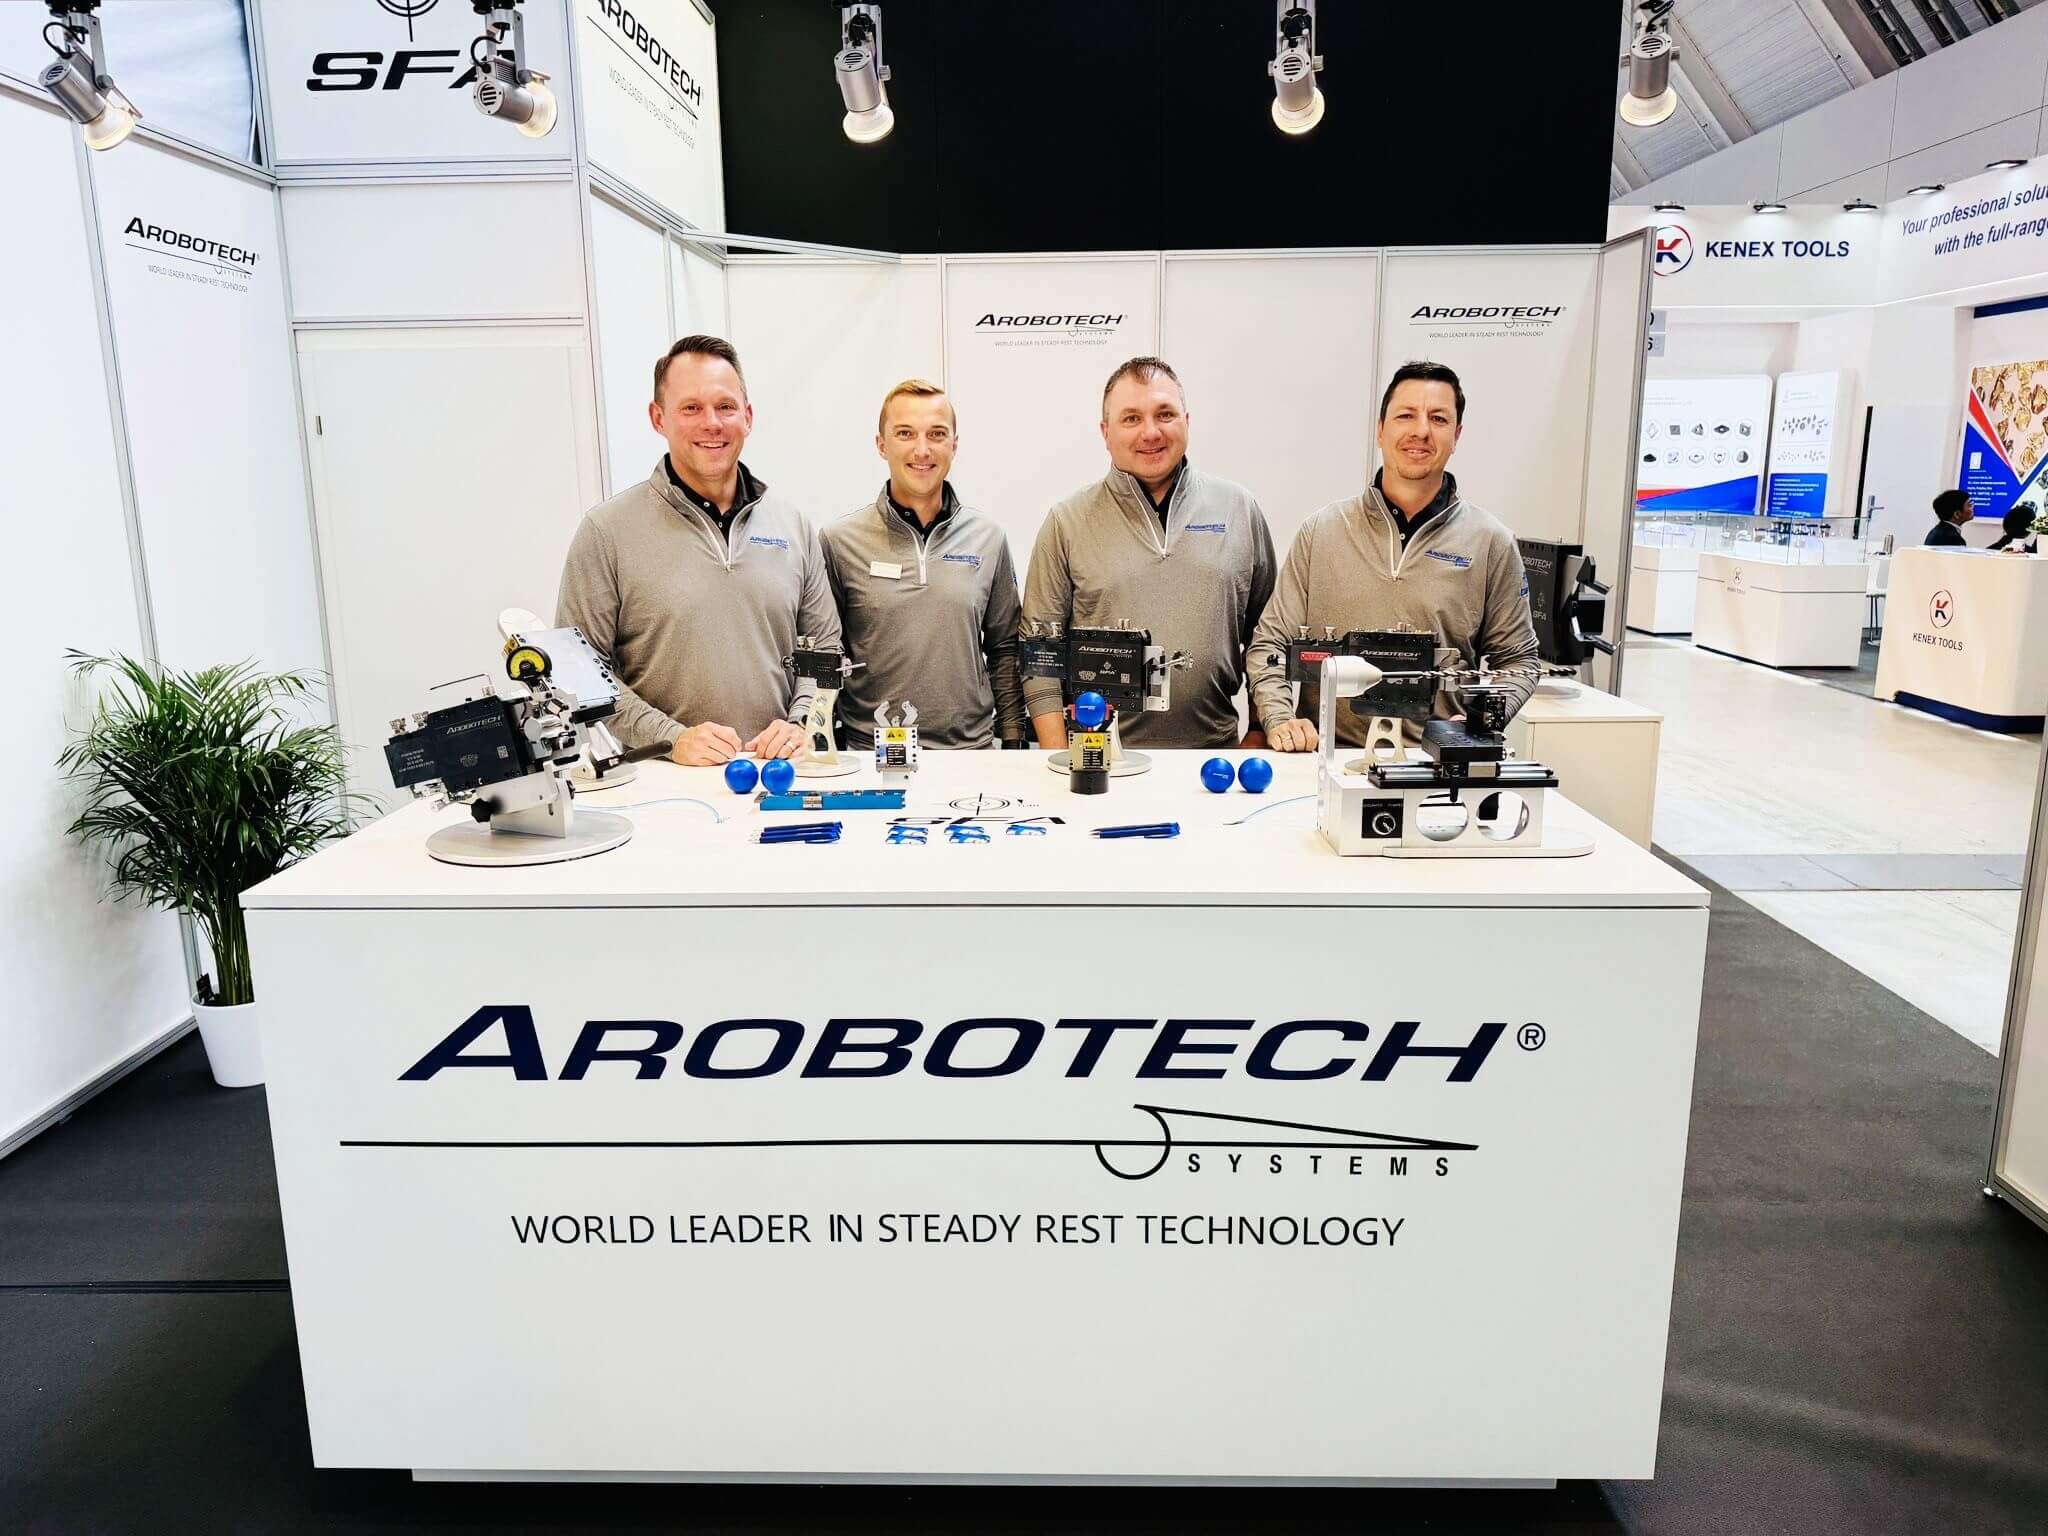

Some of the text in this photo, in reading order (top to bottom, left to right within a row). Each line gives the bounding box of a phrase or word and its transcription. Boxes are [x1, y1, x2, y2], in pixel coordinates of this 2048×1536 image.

[598, 0, 701, 106] ROBOTECH
[1902, 184, 2048, 236] Your professional solu
[124, 216, 256, 266] AROBOTECH
[1705, 240, 1850, 257] KENEX TOOLS
[1934, 216, 2048, 256] with the full-rang
[976, 313, 1123, 327] AROBOTECH
[1410, 305, 1561, 319] AROBOTECH
[1913, 632, 1963, 651] KENEX TOOLS
[1189, 1154, 1448, 1176] SYSTEMS
[511, 1213, 1405, 1246] WORLD LEADER IN STEADY REST TECHNOLOGY
